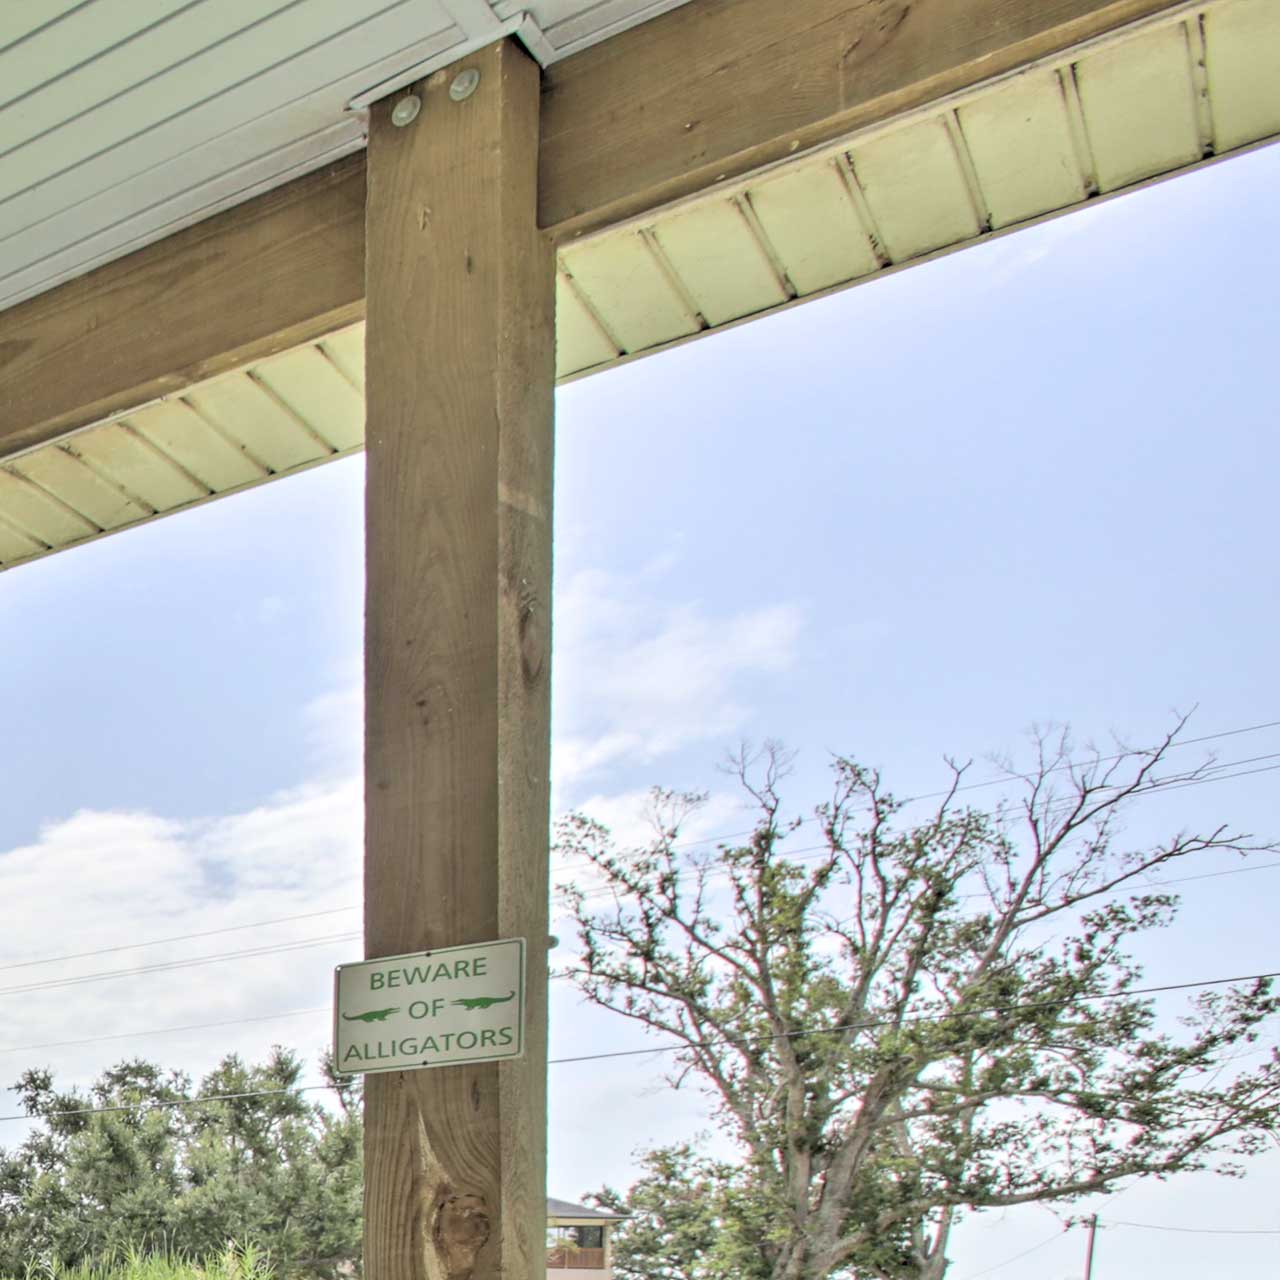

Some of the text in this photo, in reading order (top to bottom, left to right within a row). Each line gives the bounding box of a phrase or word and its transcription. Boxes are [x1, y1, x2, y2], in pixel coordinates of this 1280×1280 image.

[369, 957, 487, 991] BEWARE
[408, 997, 446, 1020] OF
[343, 1026, 513, 1063] ALLIGATORS
